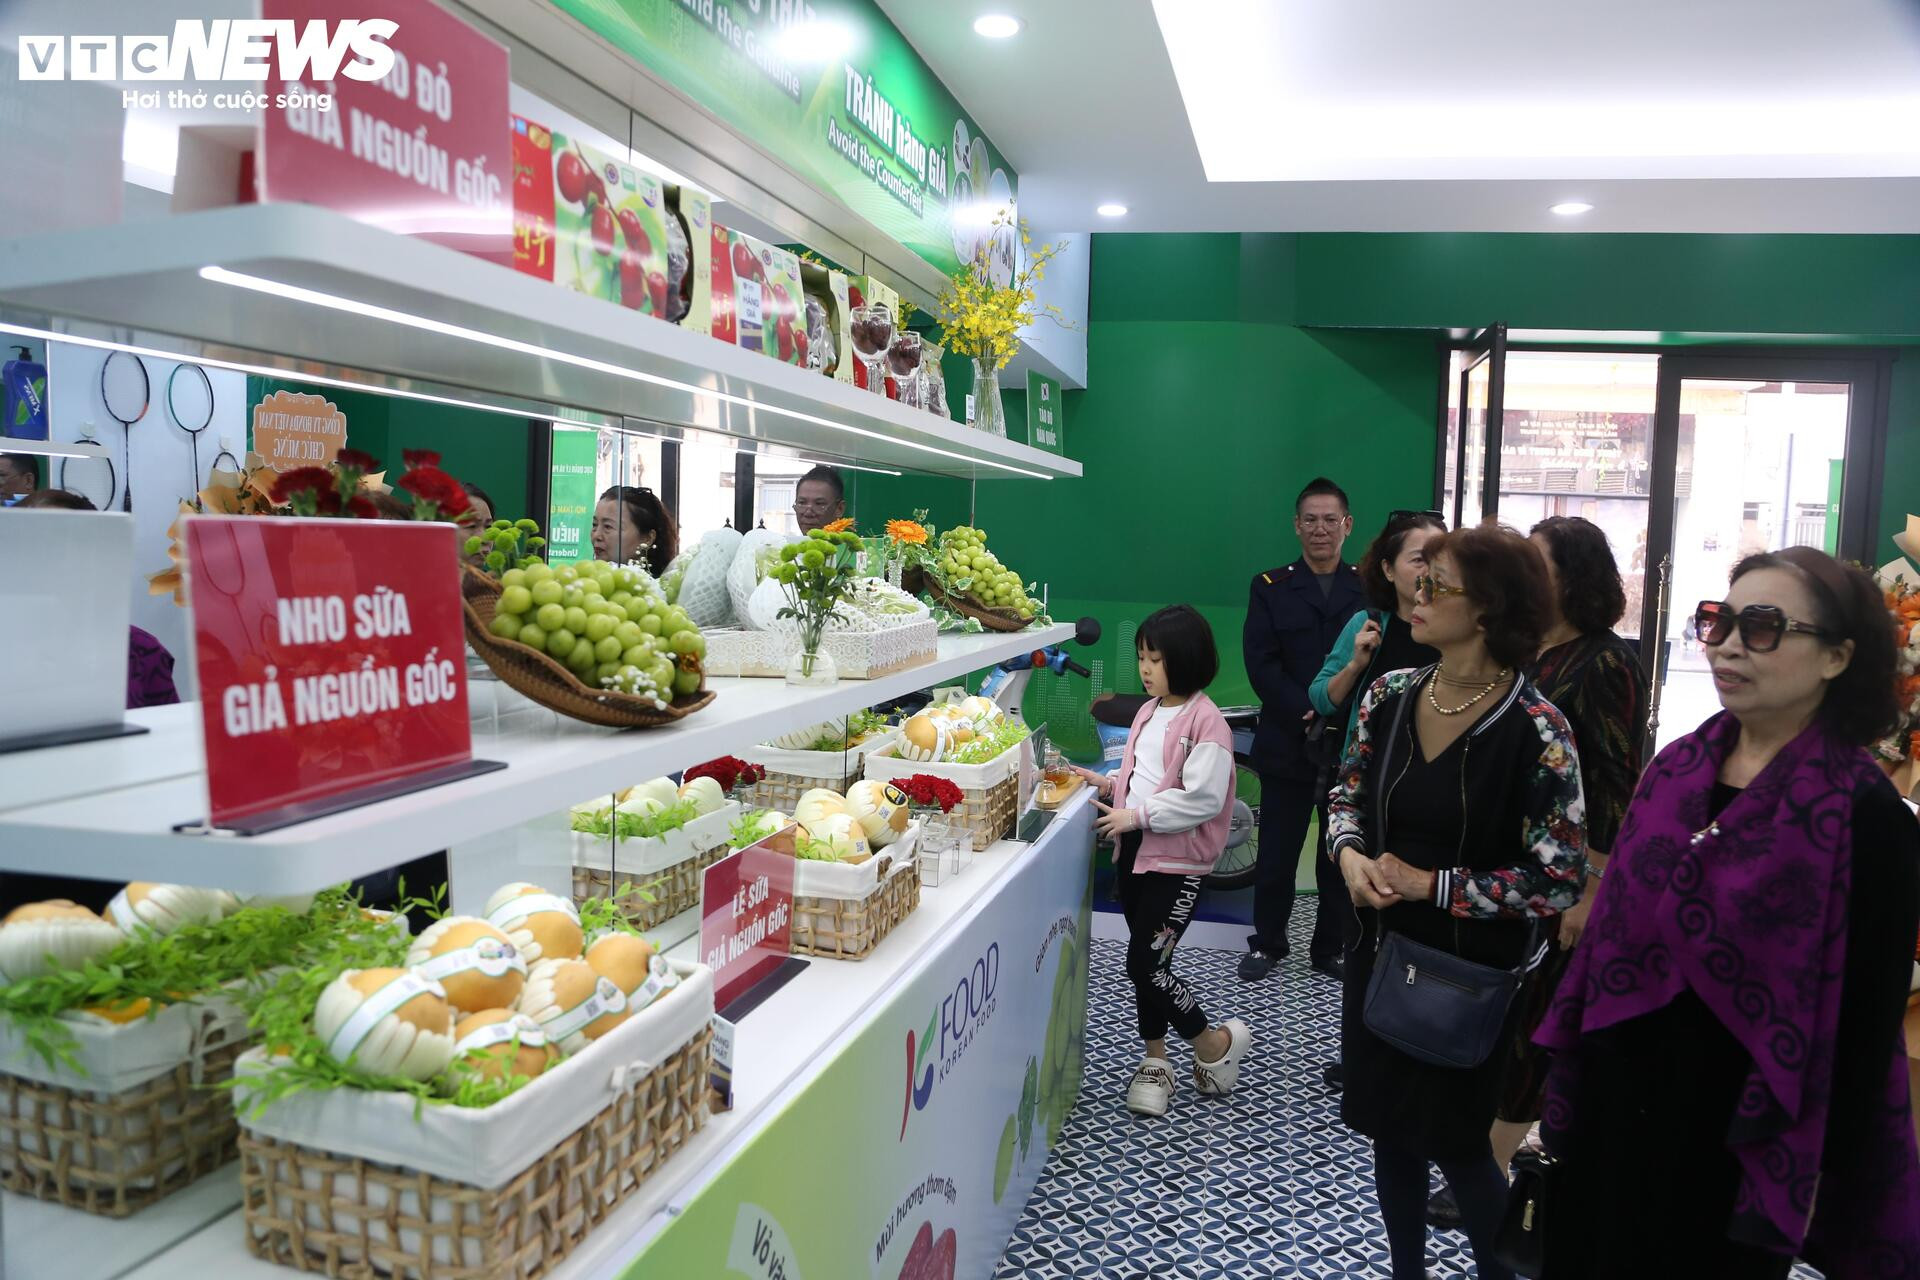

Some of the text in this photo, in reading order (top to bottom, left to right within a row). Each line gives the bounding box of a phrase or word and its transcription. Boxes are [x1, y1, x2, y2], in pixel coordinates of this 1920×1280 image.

[415, 61, 452, 123] ĐỎ
[717, 6, 743, 49] the
[744, 30, 800, 97] Genuine
[285, 80, 501, 211] GIẢ NGUỒN GỐC
[828, 118, 924, 215] Avoid the Counterfeit
[844, 63, 947, 197] TRÁNH hàng GIẢ
[277, 585, 412, 646] NHO SỮA
[223, 646, 457, 737] GIẢ NGUỒN GỐC
[707, 897, 788, 972] GIẢ NGUỒN GỐC
[732, 872, 769, 919] LÊ SỮA
[1168, 889, 1197, 925] PONY
[939, 997, 997, 1084] KOREAN FOOD
[940, 941, 999, 1061] FOOD
[1169, 982, 1196, 1014] PONY
[752, 1218, 773, 1265] Vỏ
[876, 1215, 894, 1264] Mùi
[896, 1182, 926, 1227] hương
[926, 1172, 945, 1196] thơm
